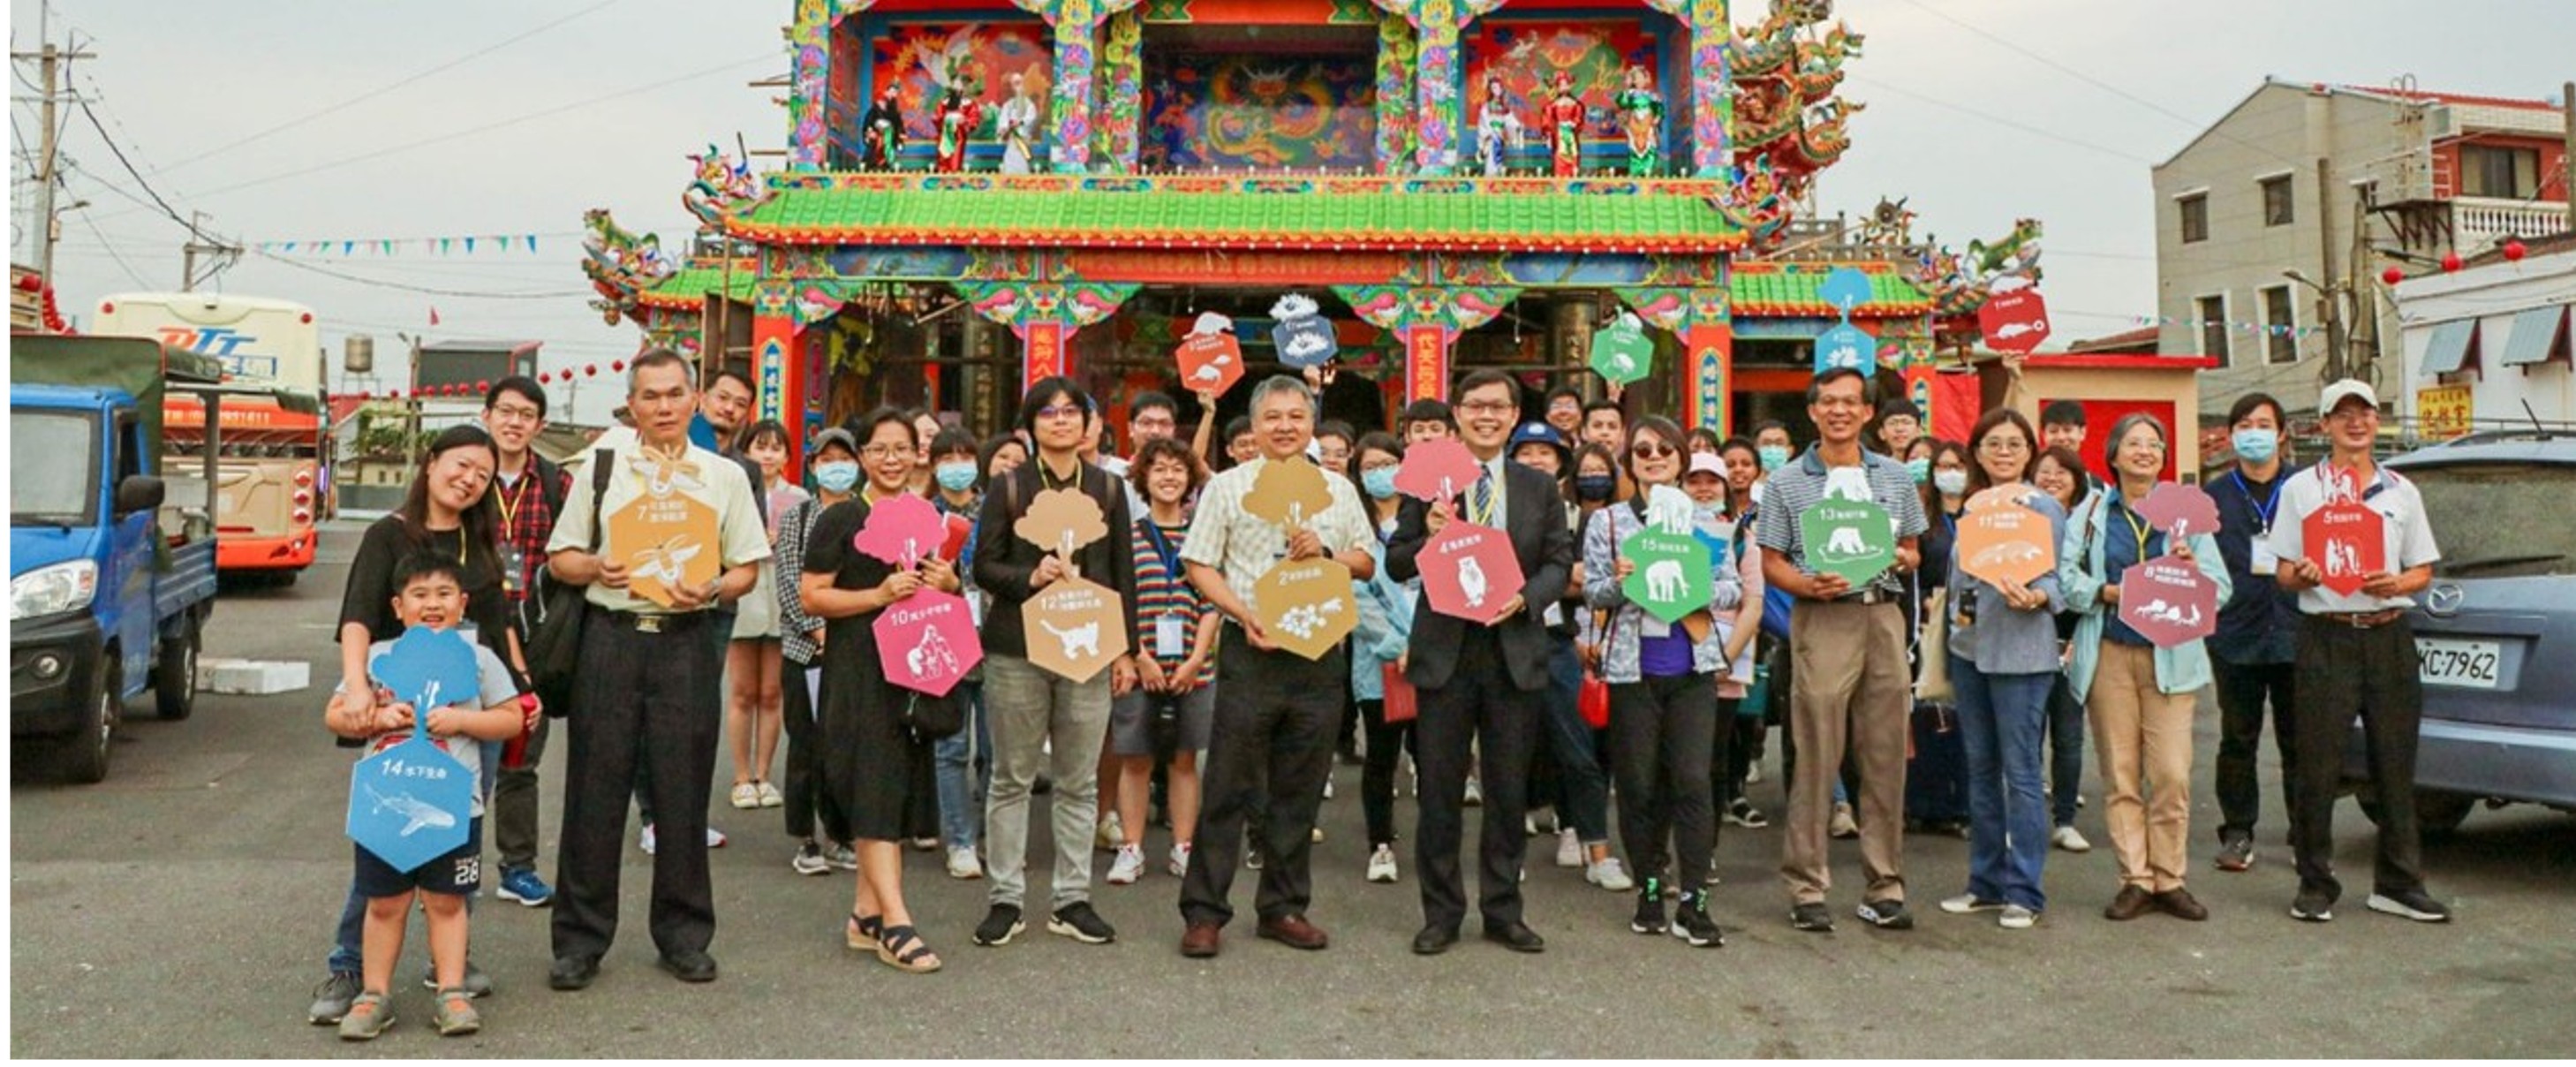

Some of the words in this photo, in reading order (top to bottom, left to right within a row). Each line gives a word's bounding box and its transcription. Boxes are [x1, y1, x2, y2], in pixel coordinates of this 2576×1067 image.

[637, 503, 648, 521] 7
[1820, 507, 1834, 521] 13
[2323, 511, 2332, 525] 5
[1978, 514, 1992, 528] 11
[1642, 537, 1657, 552] 15
[1279, 570, 1288, 586] 2
[1041, 594, 1057, 611] 12
[891, 609, 909, 626] 10
[381, 758, 404, 776] 14
[454, 860, 480, 886] 28
